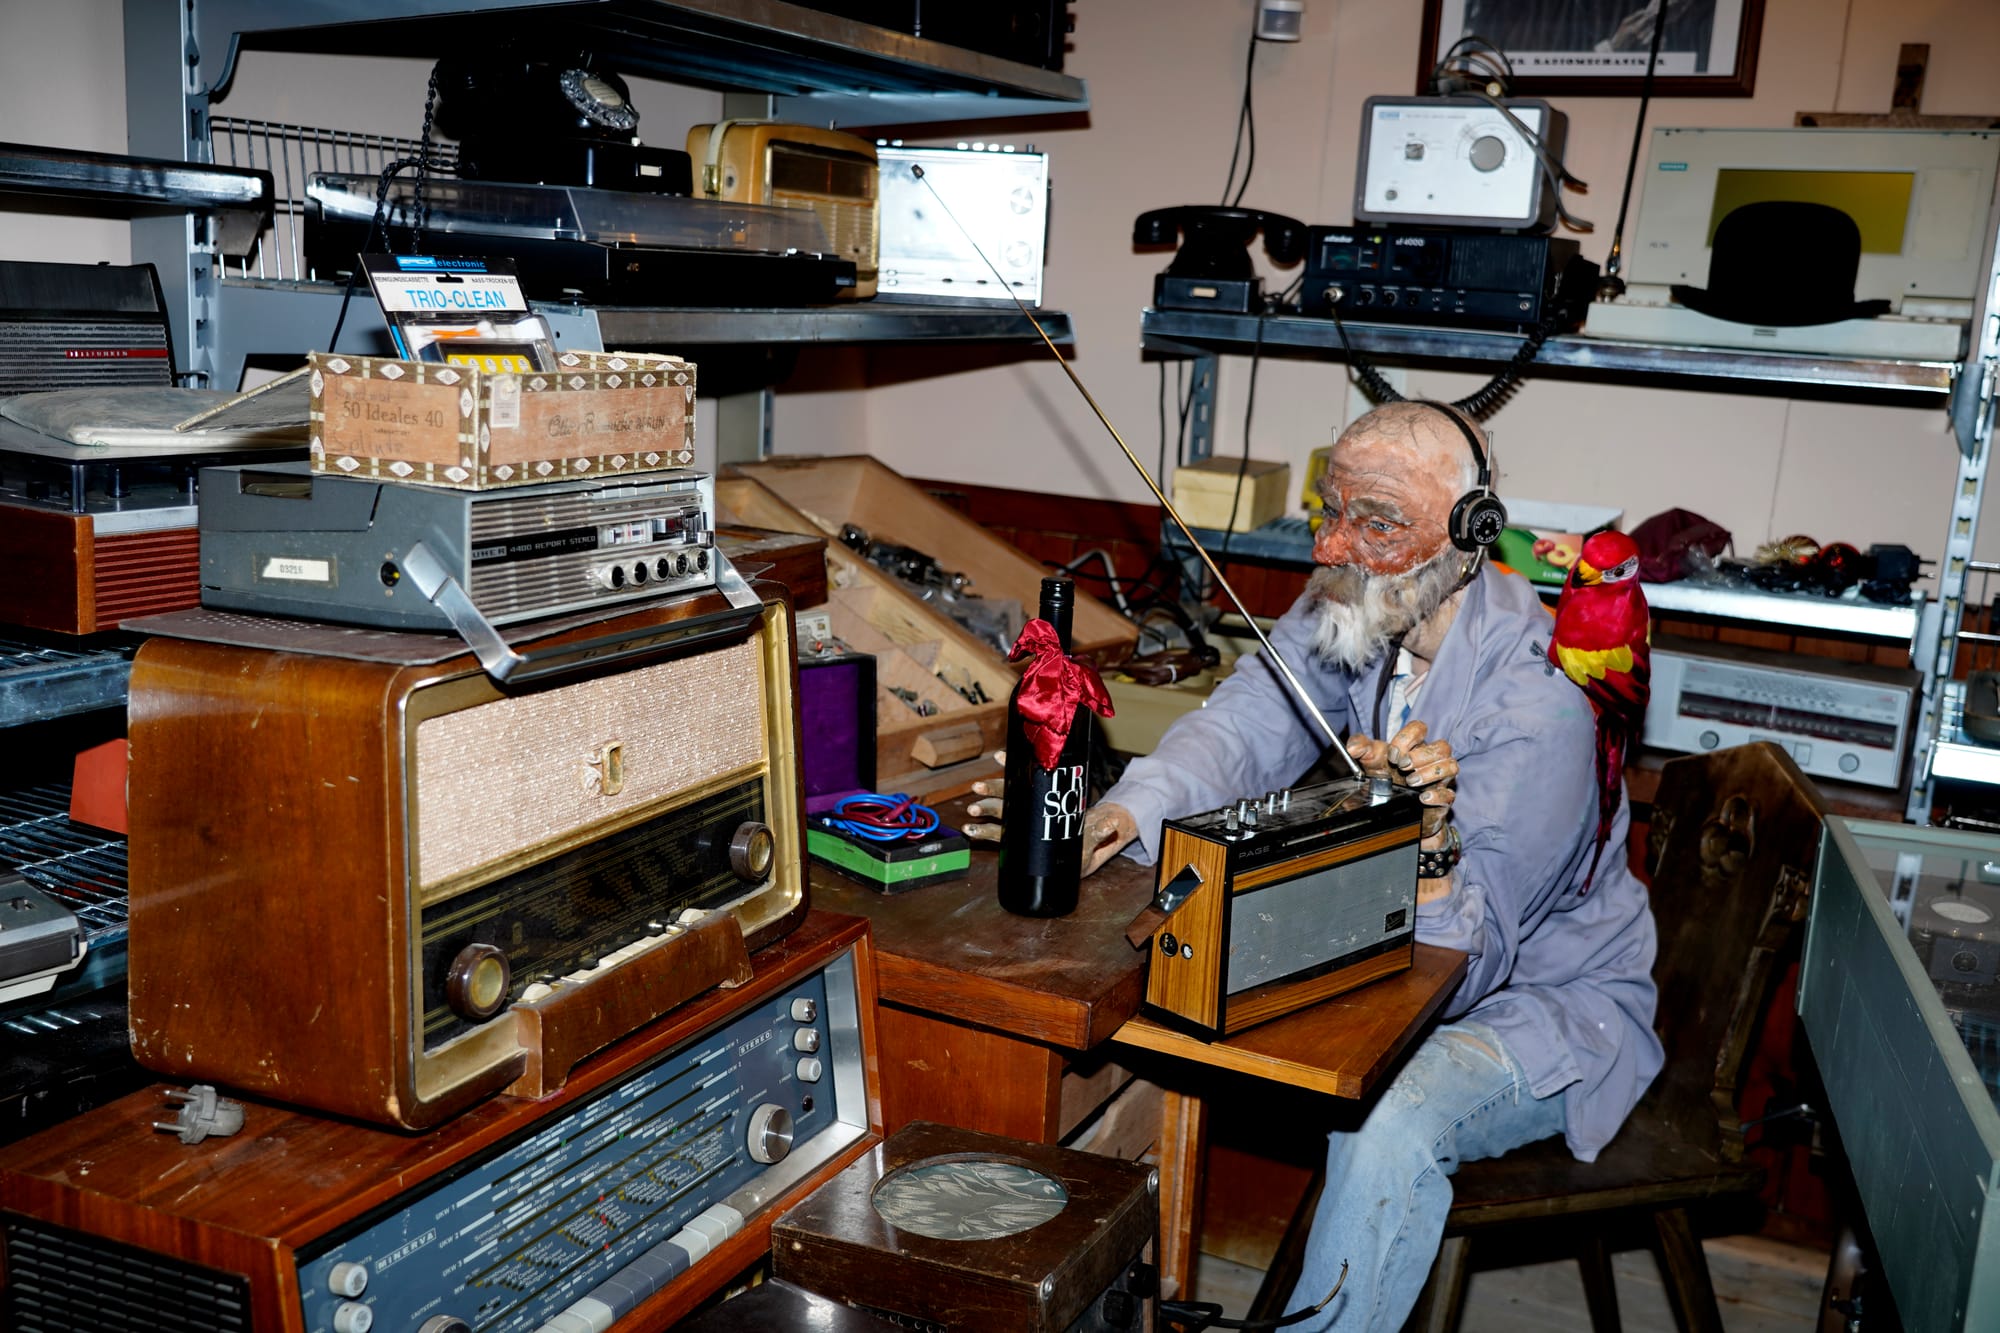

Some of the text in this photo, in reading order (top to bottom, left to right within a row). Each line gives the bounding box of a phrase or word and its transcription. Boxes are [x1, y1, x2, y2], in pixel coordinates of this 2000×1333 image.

[405, 289, 507, 309] TRIO-CLEAN
[343, 400, 444, 428] 50 Ideales 40
[535, 539, 566, 550] REPORT
[377, 1231, 436, 1271] MINERVA
